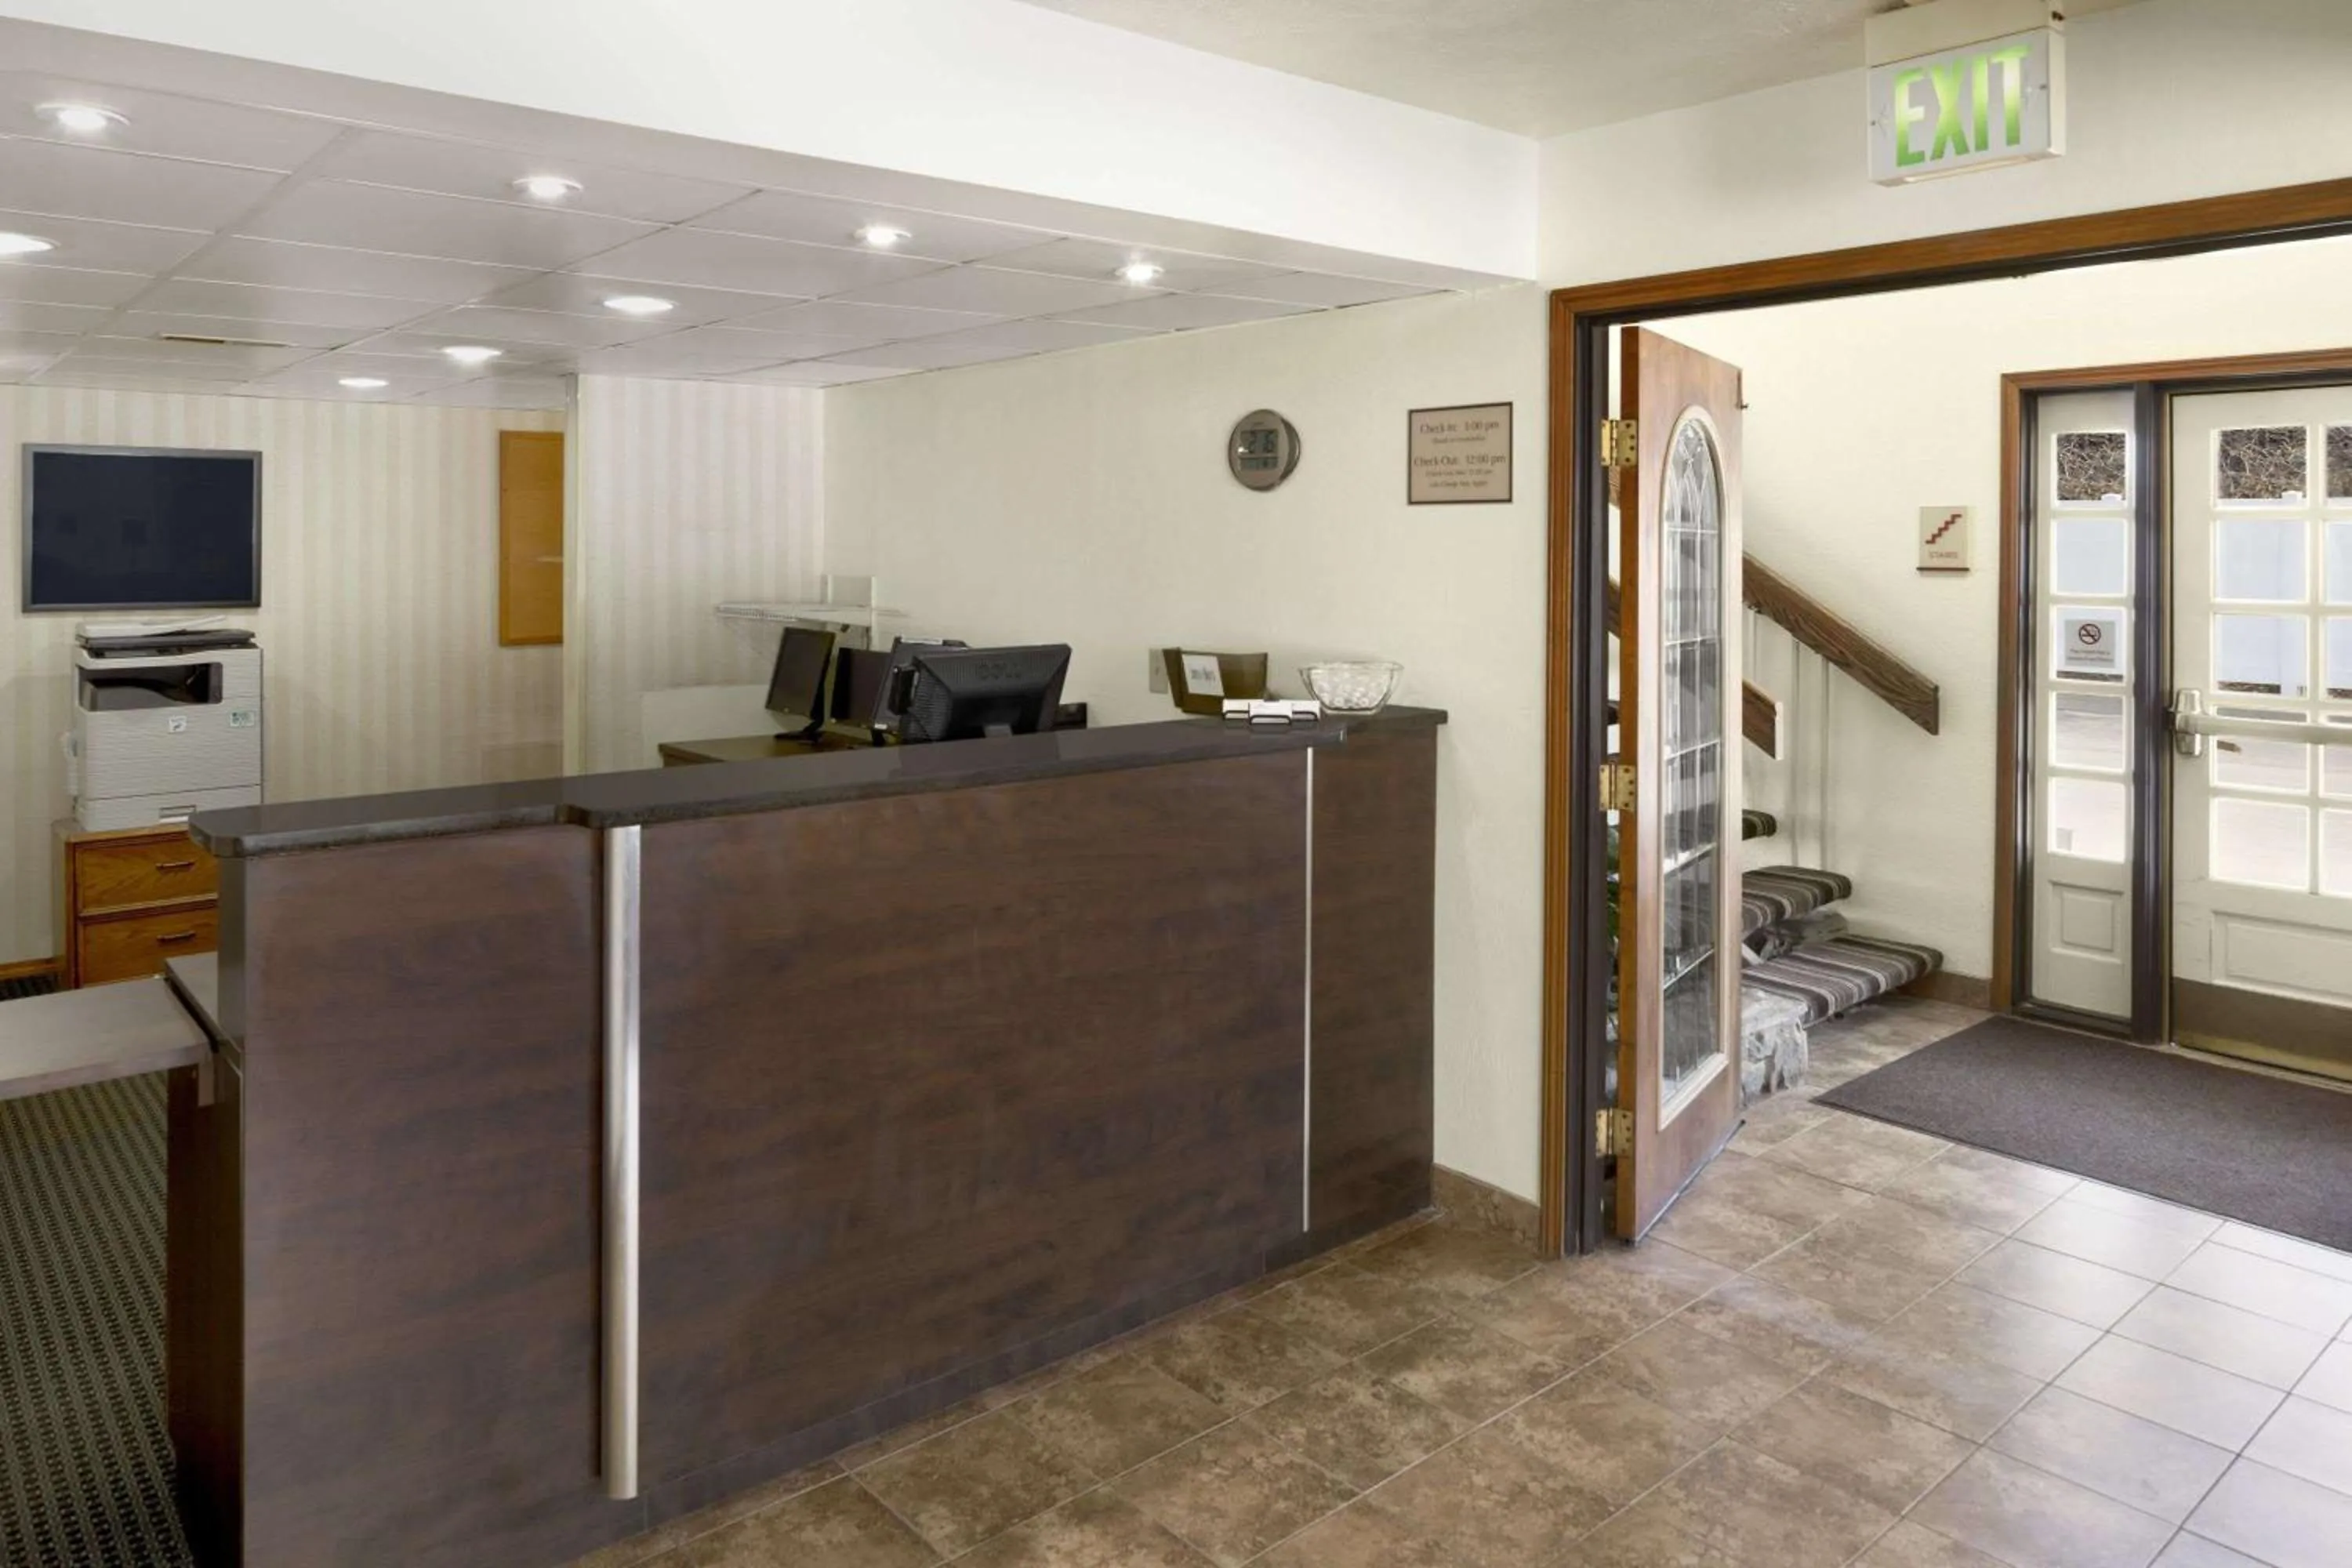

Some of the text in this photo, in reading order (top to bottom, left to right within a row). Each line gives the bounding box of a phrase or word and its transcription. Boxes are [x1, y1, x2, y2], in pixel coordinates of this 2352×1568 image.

[1895, 44, 2032, 167] EXIT
[1484, 422, 1499, 432] pm
[1490, 456, 1506, 466] pm
